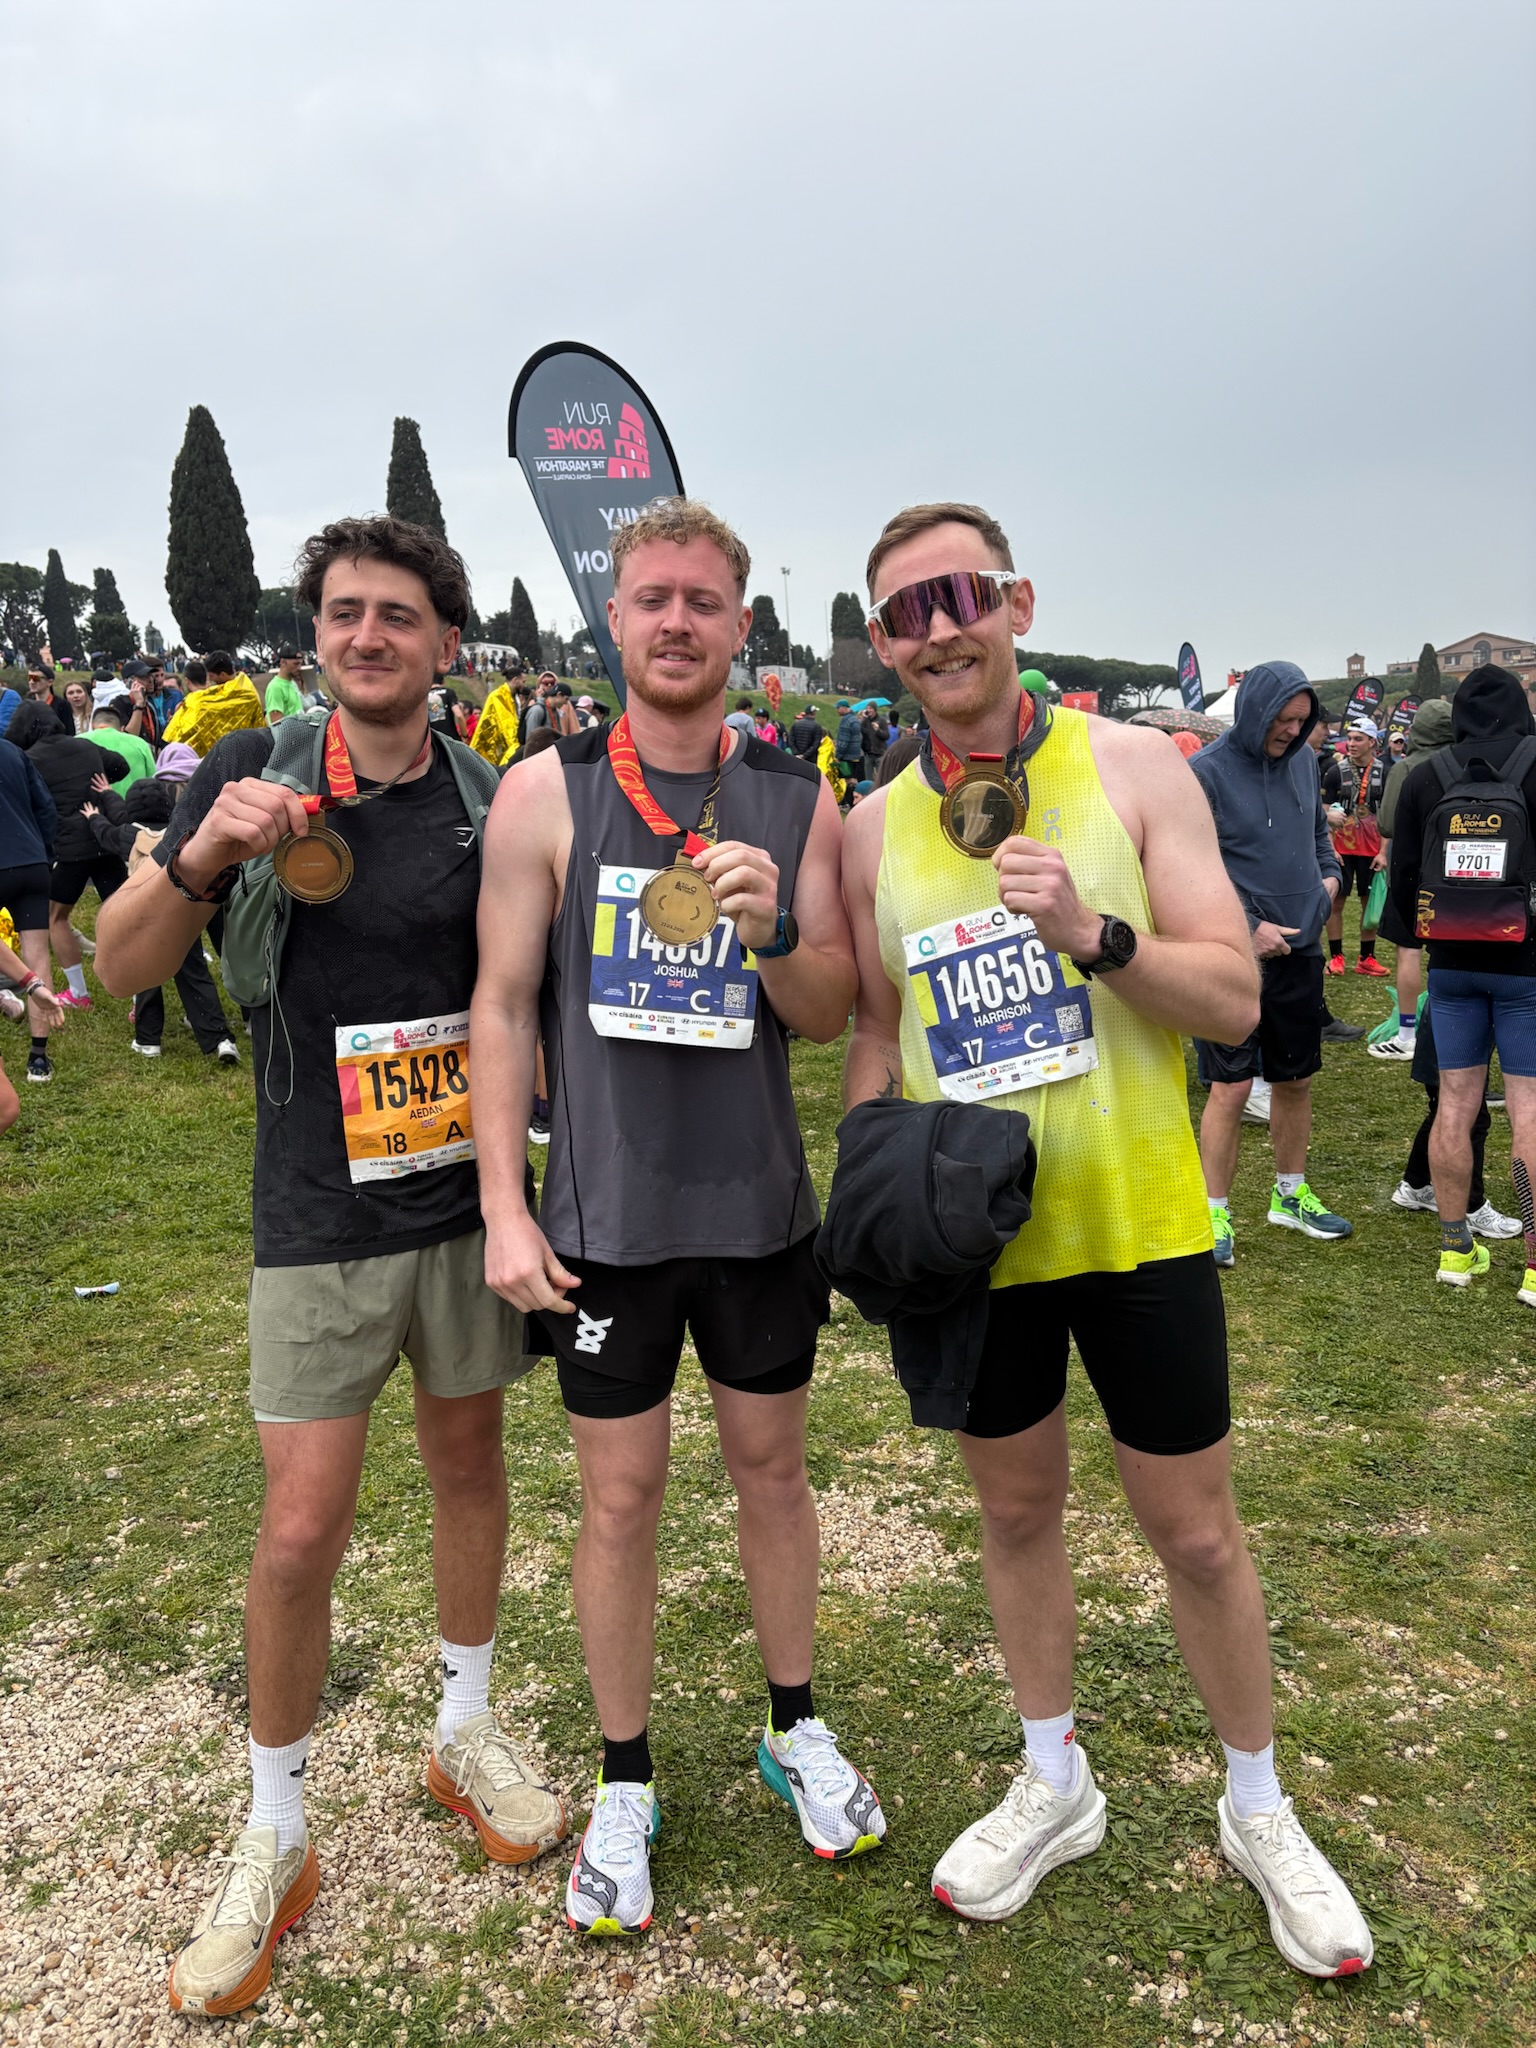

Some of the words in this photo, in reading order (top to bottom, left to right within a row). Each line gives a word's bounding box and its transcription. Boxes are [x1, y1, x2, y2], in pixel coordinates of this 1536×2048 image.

[1463, 820, 1487, 828] ROME
[1458, 854, 1491, 870] 9701
[966, 916, 983, 927] RUN
[969, 922, 992, 935] ROME
[653, 965, 699, 979] JOSHUA
[936, 939, 1054, 1020] 14656
[628, 982, 651, 1007] 17
[689, 989, 711, 1013] C
[973, 1002, 1032, 1028] HARRISON
[405, 1026, 422, 1034] RUN
[407, 1031, 426, 1040] ROME
[1023, 1023, 1048, 1049] C
[962, 1037, 984, 1066] 17
[365, 1050, 469, 1111] 15428
[409, 1104, 444, 1120] AEDAN
[445, 1120, 465, 1143] A
[383, 1132, 408, 1155] 18
